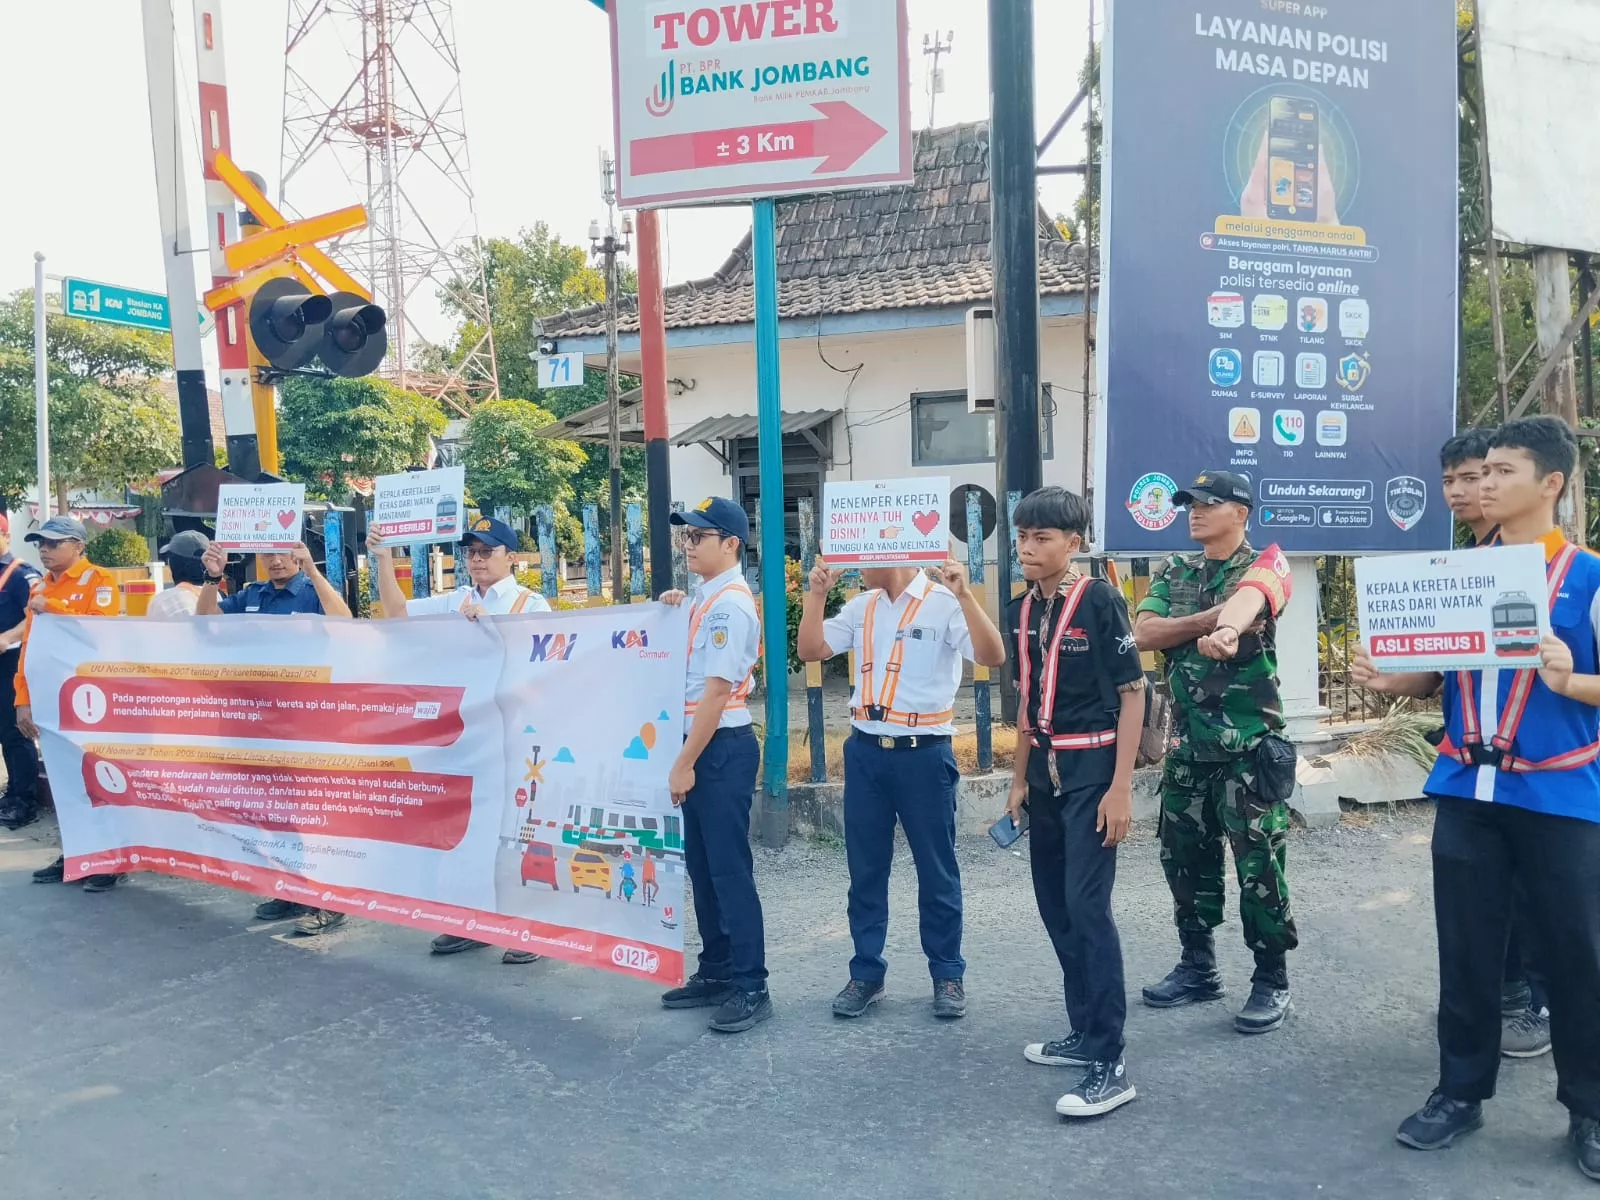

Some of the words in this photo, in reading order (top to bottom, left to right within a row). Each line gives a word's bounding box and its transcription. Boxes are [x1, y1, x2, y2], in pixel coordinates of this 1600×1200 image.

[1260, 0, 1300, 14] SUPER
[1303, 4, 1328, 19] APP
[653, 0, 838, 50] TOWER
[1195, 13, 1312, 51] LAYANAN
[1317, 31, 1388, 62] POLISI
[700, 59, 721, 72] BPR
[1215, 48, 1288, 78] MASA
[1293, 59, 1369, 89] DEPAN
[680, 69, 744, 96] BANK
[750, 56, 870, 92] JOMBANG
[736, 135, 750, 155] 3
[757, 132, 794, 153] Km
[1225, 221, 1263, 234] melalui
[1265, 226, 1325, 240] genggaman
[1218, 238, 1240, 248] Akses
[1241, 239, 1271, 250] layanan
[1293, 243, 1319, 254] TANPA
[1320, 246, 1347, 257] HARUS
[1228, 255, 1294, 276] Beragam
[1296, 260, 1353, 279] layanan
[1219, 273, 1256, 289] polisi
[1258, 276, 1315, 292] tersedia
[1316, 280, 1360, 296] online
[153, 300, 164, 311] KA
[126, 308, 162, 321] JOMBANG
[1219, 331, 1233, 340] SIM
[1299, 336, 1325, 345] TILANG
[548, 357, 569, 382] 71
[1211, 389, 1238, 398] DUMAS
[1250, 391, 1286, 401] E-SURVEY
[1293, 393, 1328, 402] LAPORAN
[1341, 393, 1364, 403] SURAT
[1330, 402, 1375, 412] KEHILANGAN
[1284, 416, 1303, 429] 110
[1235, 449, 1253, 457] INFO
[1283, 450, 1294, 458] 110
[1230, 458, 1258, 466] RAWAN
[402, 487, 424, 497] KERETA
[1268, 483, 1306, 497] Unduh
[1307, 484, 1366, 500] Sekarang!
[223, 497, 265, 507] MENEMPER
[268, 496, 296, 507] KERETA
[831, 495, 892, 510] MENEMPER
[896, 493, 939, 507] KERETA
[830, 511, 879, 525] SAKITNYA
[882, 510, 902, 523] TUH
[1276, 514, 1298, 523] Google
[1298, 514, 1311, 524] Play
[1334, 515, 1349, 524] App
[1349, 515, 1367, 524] Store
[399, 522, 426, 533] SERIUS
[830, 527, 860, 540] DISINI
[830, 542, 862, 553] TUNGGU
[864, 541, 875, 552] KA
[877, 540, 898, 551] YANG
[900, 539, 941, 550] MELINTAS
[1366, 581, 1409, 596] KEPALA
[1413, 577, 1457, 594] KERETA
[1461, 575, 1496, 591] LEBIH
[1367, 598, 1405, 613] KERAS
[1409, 596, 1437, 611] DARI
[1440, 594, 1483, 609] WATAK
[1368, 615, 1436, 631] MANTANMU
[1375, 636, 1410, 653] ASLI
[1413, 635, 1471, 652] SERIUS
[639, 650, 670, 660] Commuter
[112, 692, 134, 704] Pada
[135, 693, 191, 706] perpotongan
[192, 695, 228, 708] sebidang
[229, 697, 254, 708] antara
[276, 698, 304, 710] kereta
[305, 699, 318, 711] api
[320, 699, 336, 711] dan
[337, 702, 360, 714] jalan,
[361, 702, 395, 714] pemakai
[416, 704, 439, 717] wajib
[113, 706, 176, 717] mendahulukan
[177, 707, 220, 720] perjalanan
[221, 709, 246, 721] kereta
[247, 710, 263, 722] api.
[160, 769, 208, 780] kendaraan
[210, 769, 250, 781] bermotor
[251, 773, 272, 784] yang
[329, 775, 357, 786] ketika
[358, 777, 381, 789] sinyal
[382, 779, 407, 790] sudah
[408, 781, 447, 795] berbunyi,
[179, 783, 204, 794] sudah
[206, 784, 231, 795] mulai
[232, 785, 267, 797] ditutup,
[269, 786, 306, 798] dan/atau
[307, 788, 323, 798] ada
[324, 788, 352, 800] isyarat
[352, 789, 367, 801] lain
[368, 791, 387, 803] akan
[388, 793, 423, 807] dipidana
[243, 799, 264, 810] lama
[267, 800, 273, 809] 3
[274, 800, 299, 811] bulan
[300, 802, 320, 812] atau
[321, 802, 348, 813] denda
[348, 804, 374, 817] paling
[268, 814, 288, 823] Ribu
[289, 814, 321, 827] Rupiah
